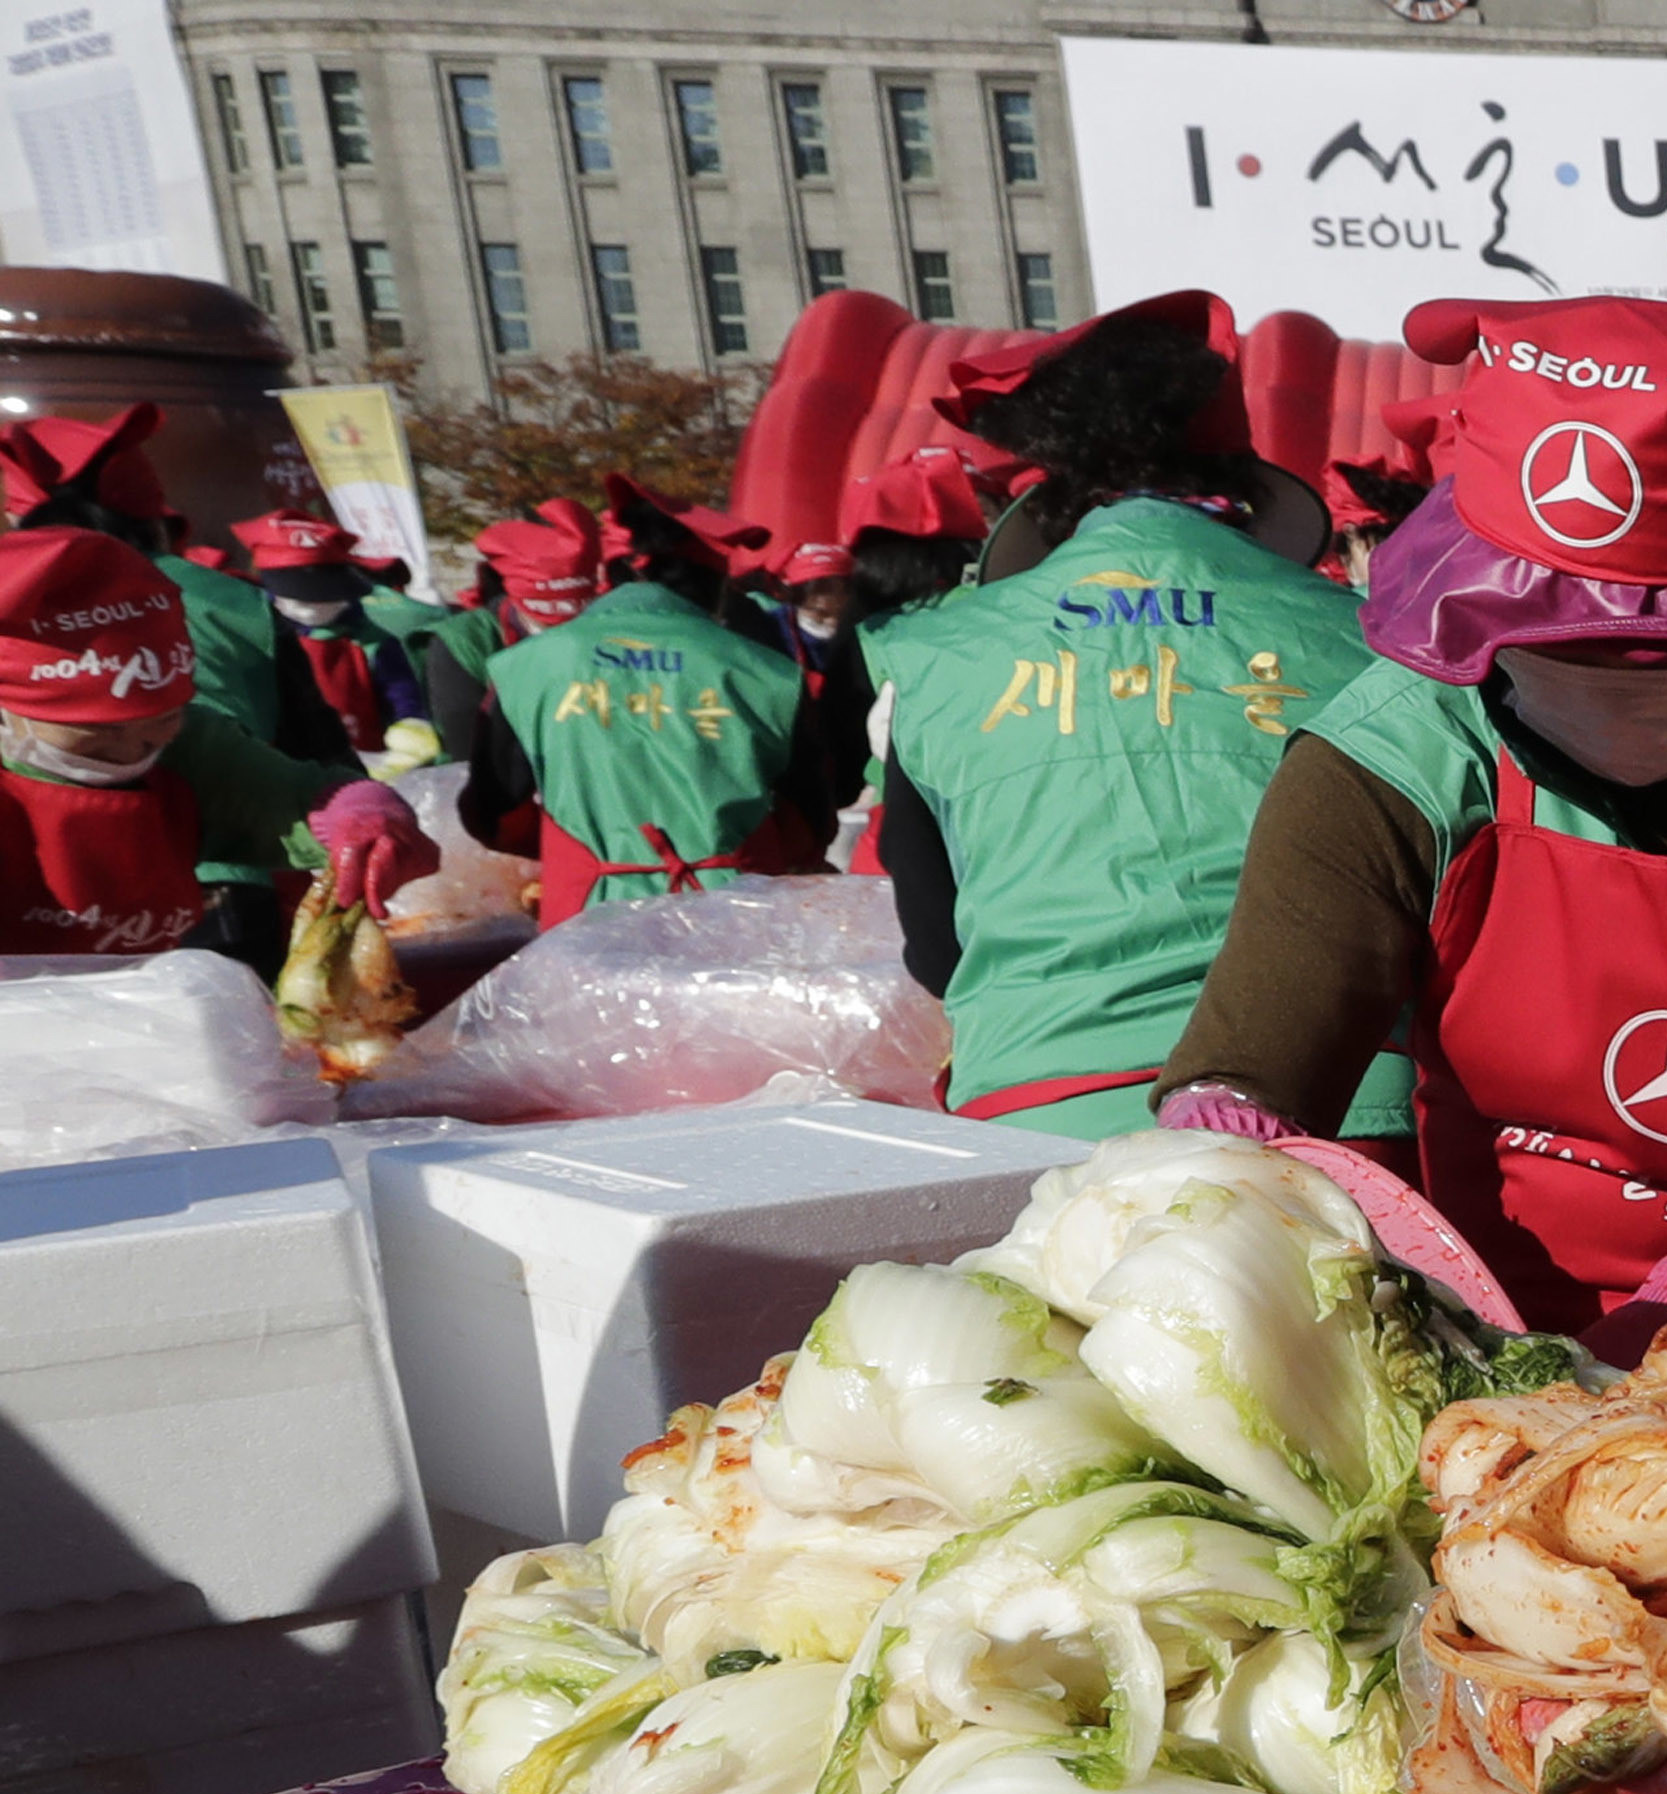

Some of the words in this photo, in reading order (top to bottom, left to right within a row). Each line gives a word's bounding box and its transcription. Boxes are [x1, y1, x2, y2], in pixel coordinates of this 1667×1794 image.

[1311, 214, 1461, 251] SEOUL
[1054, 587, 1217, 632] SMU
[591, 645, 684, 673] SMU
[554, 678, 735, 740] 새마을
[980, 644, 1309, 736] 새마을
